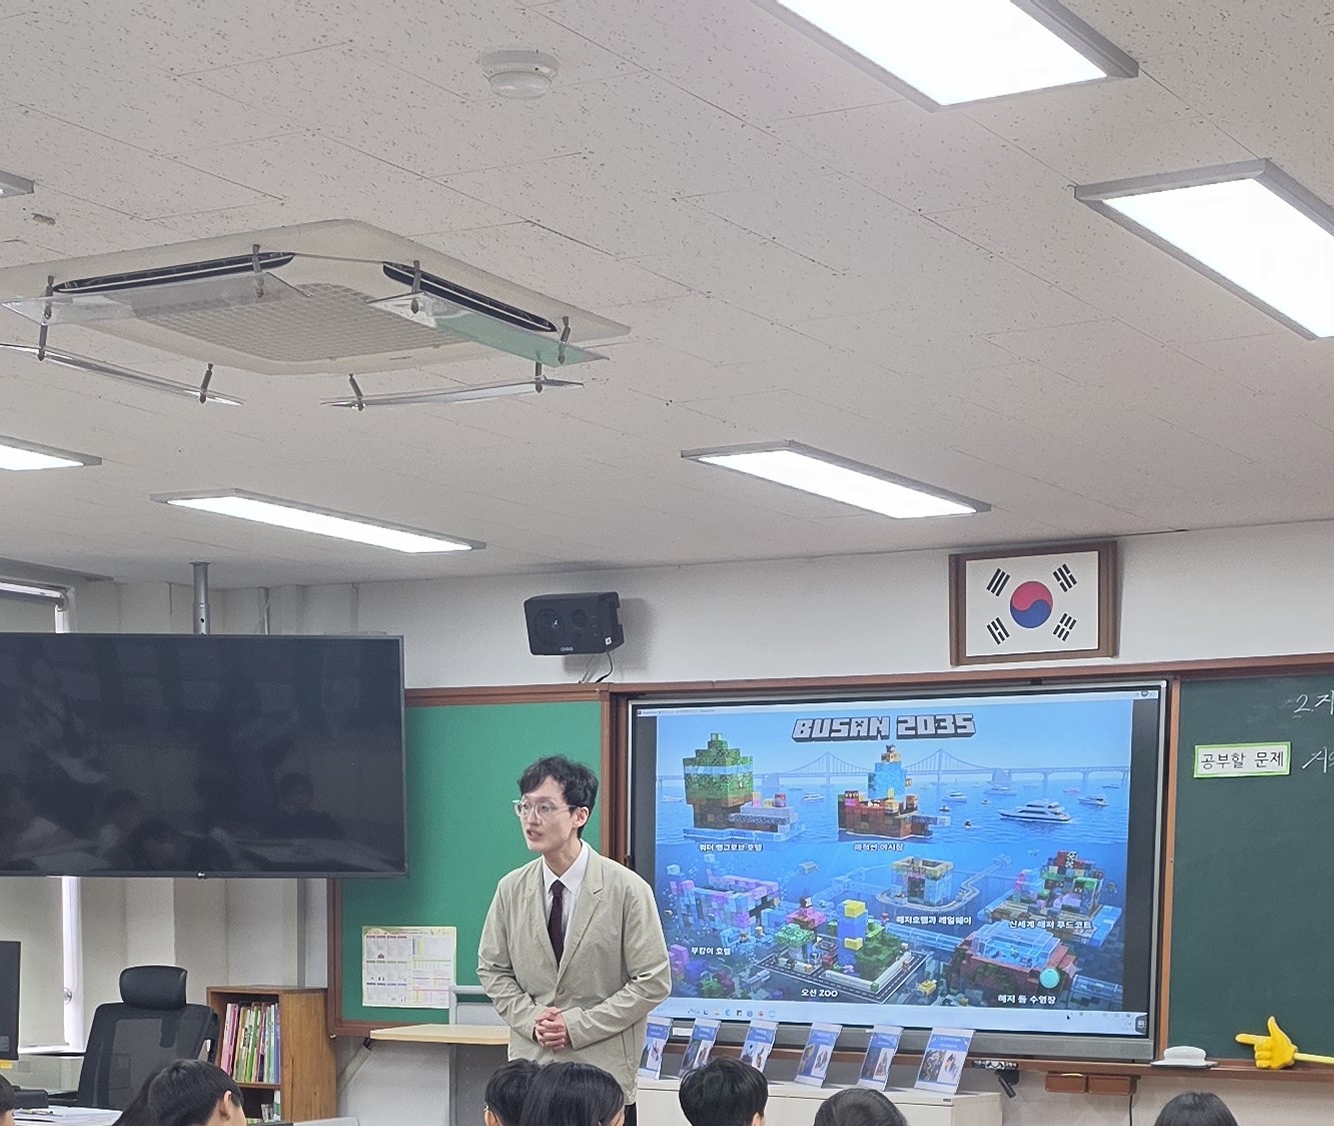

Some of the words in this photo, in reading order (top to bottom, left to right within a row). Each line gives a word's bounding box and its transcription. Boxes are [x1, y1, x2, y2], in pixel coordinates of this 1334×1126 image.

[792, 716, 890, 742] BUSAN
[896, 713, 976, 739] 2035
[1201, 753, 1246, 770] 공부할
[1254, 751, 1284, 768] 문제
[801, 988, 817, 997] 오션
[819, 989, 839, 998] ZOO
